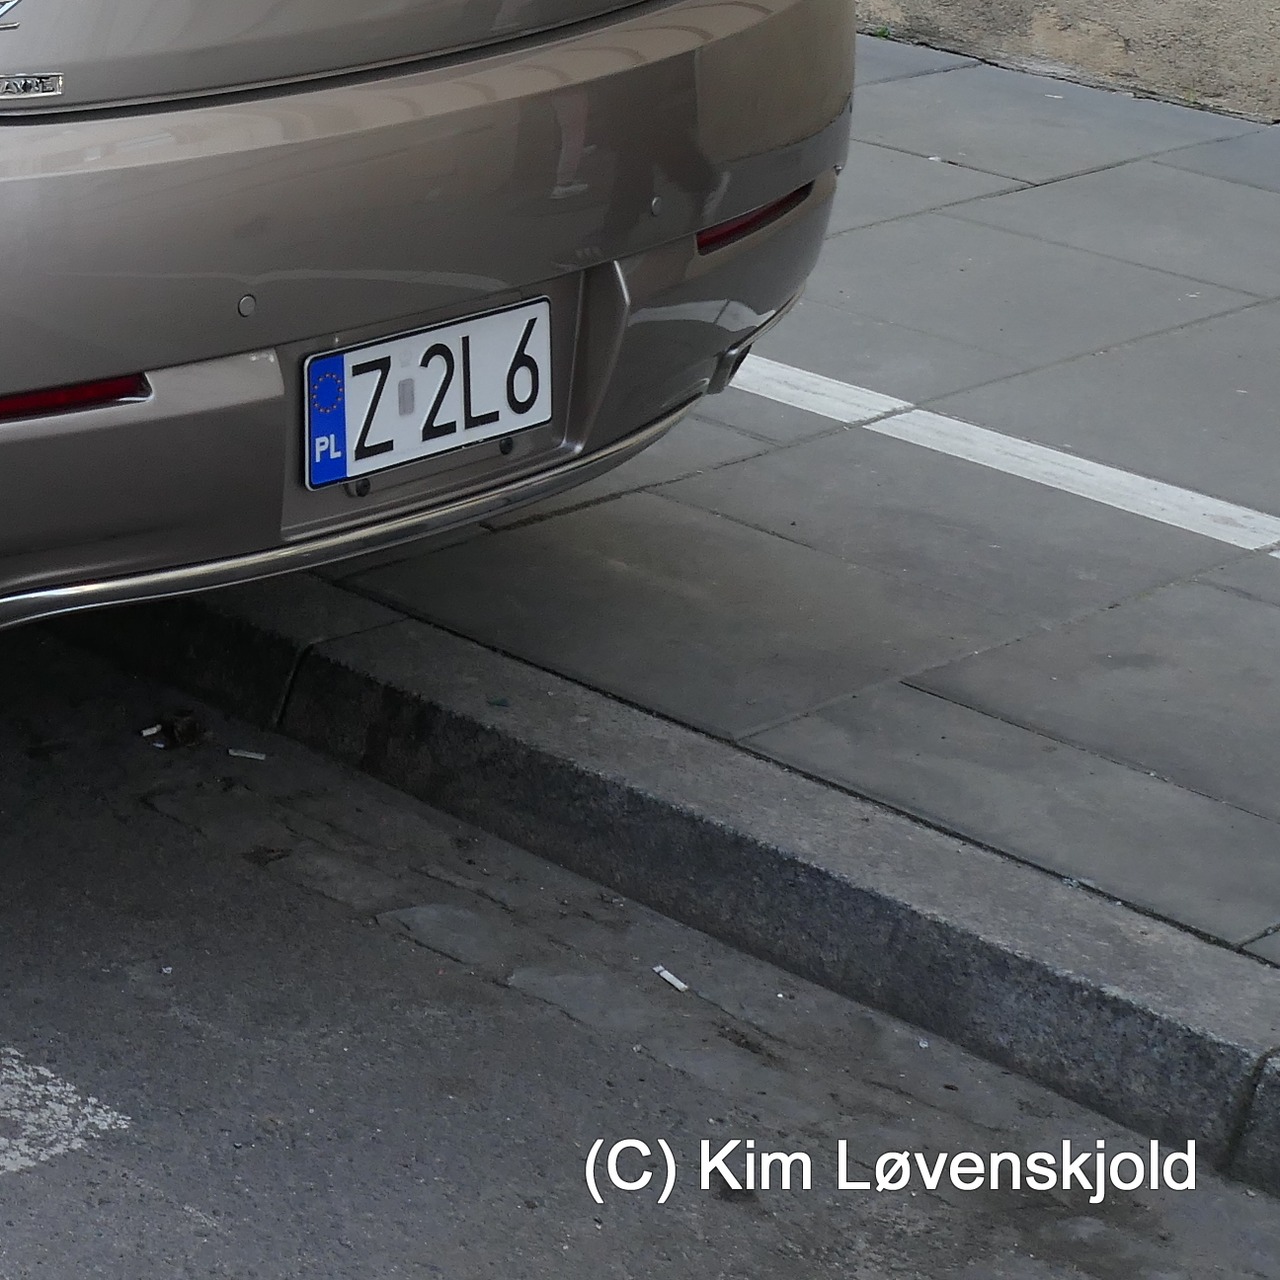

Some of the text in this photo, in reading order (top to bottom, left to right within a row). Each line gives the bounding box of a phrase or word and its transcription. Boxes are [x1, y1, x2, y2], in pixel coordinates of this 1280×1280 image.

[351, 317, 539, 461] Z 2L6
[315, 433, 342, 463] PL
